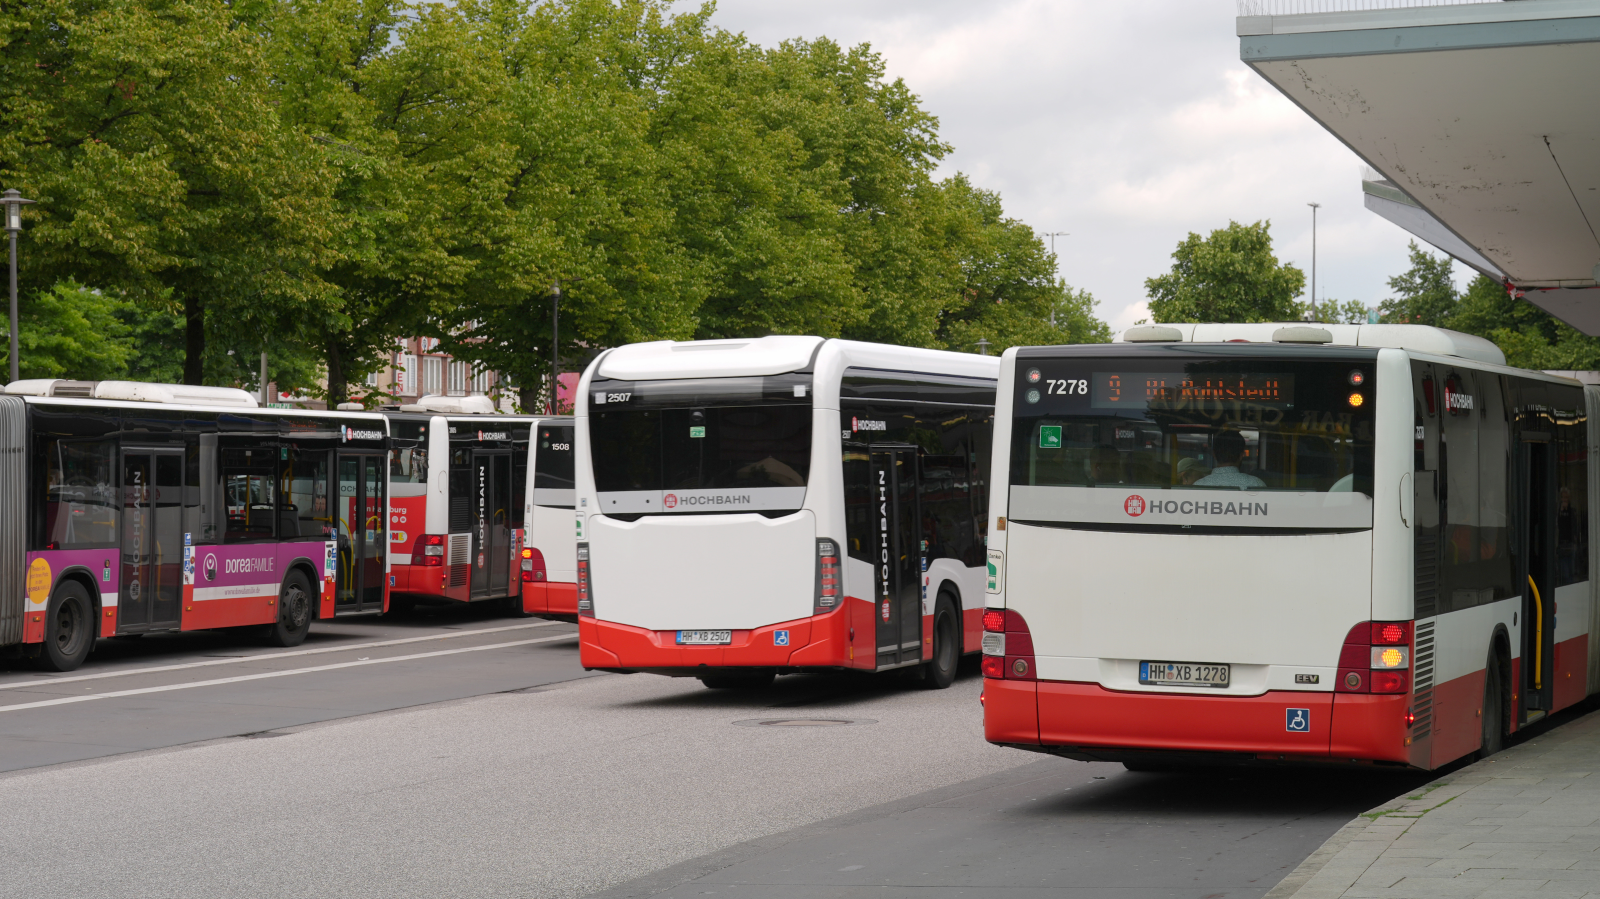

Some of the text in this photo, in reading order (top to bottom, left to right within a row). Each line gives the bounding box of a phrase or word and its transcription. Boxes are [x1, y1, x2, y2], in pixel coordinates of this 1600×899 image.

[1046, 379, 1088, 395] 7278
[1108, 375, 1121, 401] 9
[607, 392, 632, 403] 2507
[1450, 393, 1474, 409] HOCHBAHN
[858, 420, 886, 431] HOCHBAHN
[353, 430, 382, 439] HOCHBAHN
[483, 432, 506, 440] HOCHBAHN
[551, 443, 570, 451] 1508
[680, 495, 750, 505] HOCHBAHN
[1149, 500, 1268, 516] HOCHBAHN
[132, 471, 141, 576] HOCHBAHN
[878, 470, 889, 596] HOCHBAHN
[682, 631, 730, 641] HH XB 2507
[1149, 664, 1166, 680] HH
[1175, 665, 1192, 681] XB
[1195, 666, 1227, 682] 1278
[1296, 674, 1318, 683] EEV
